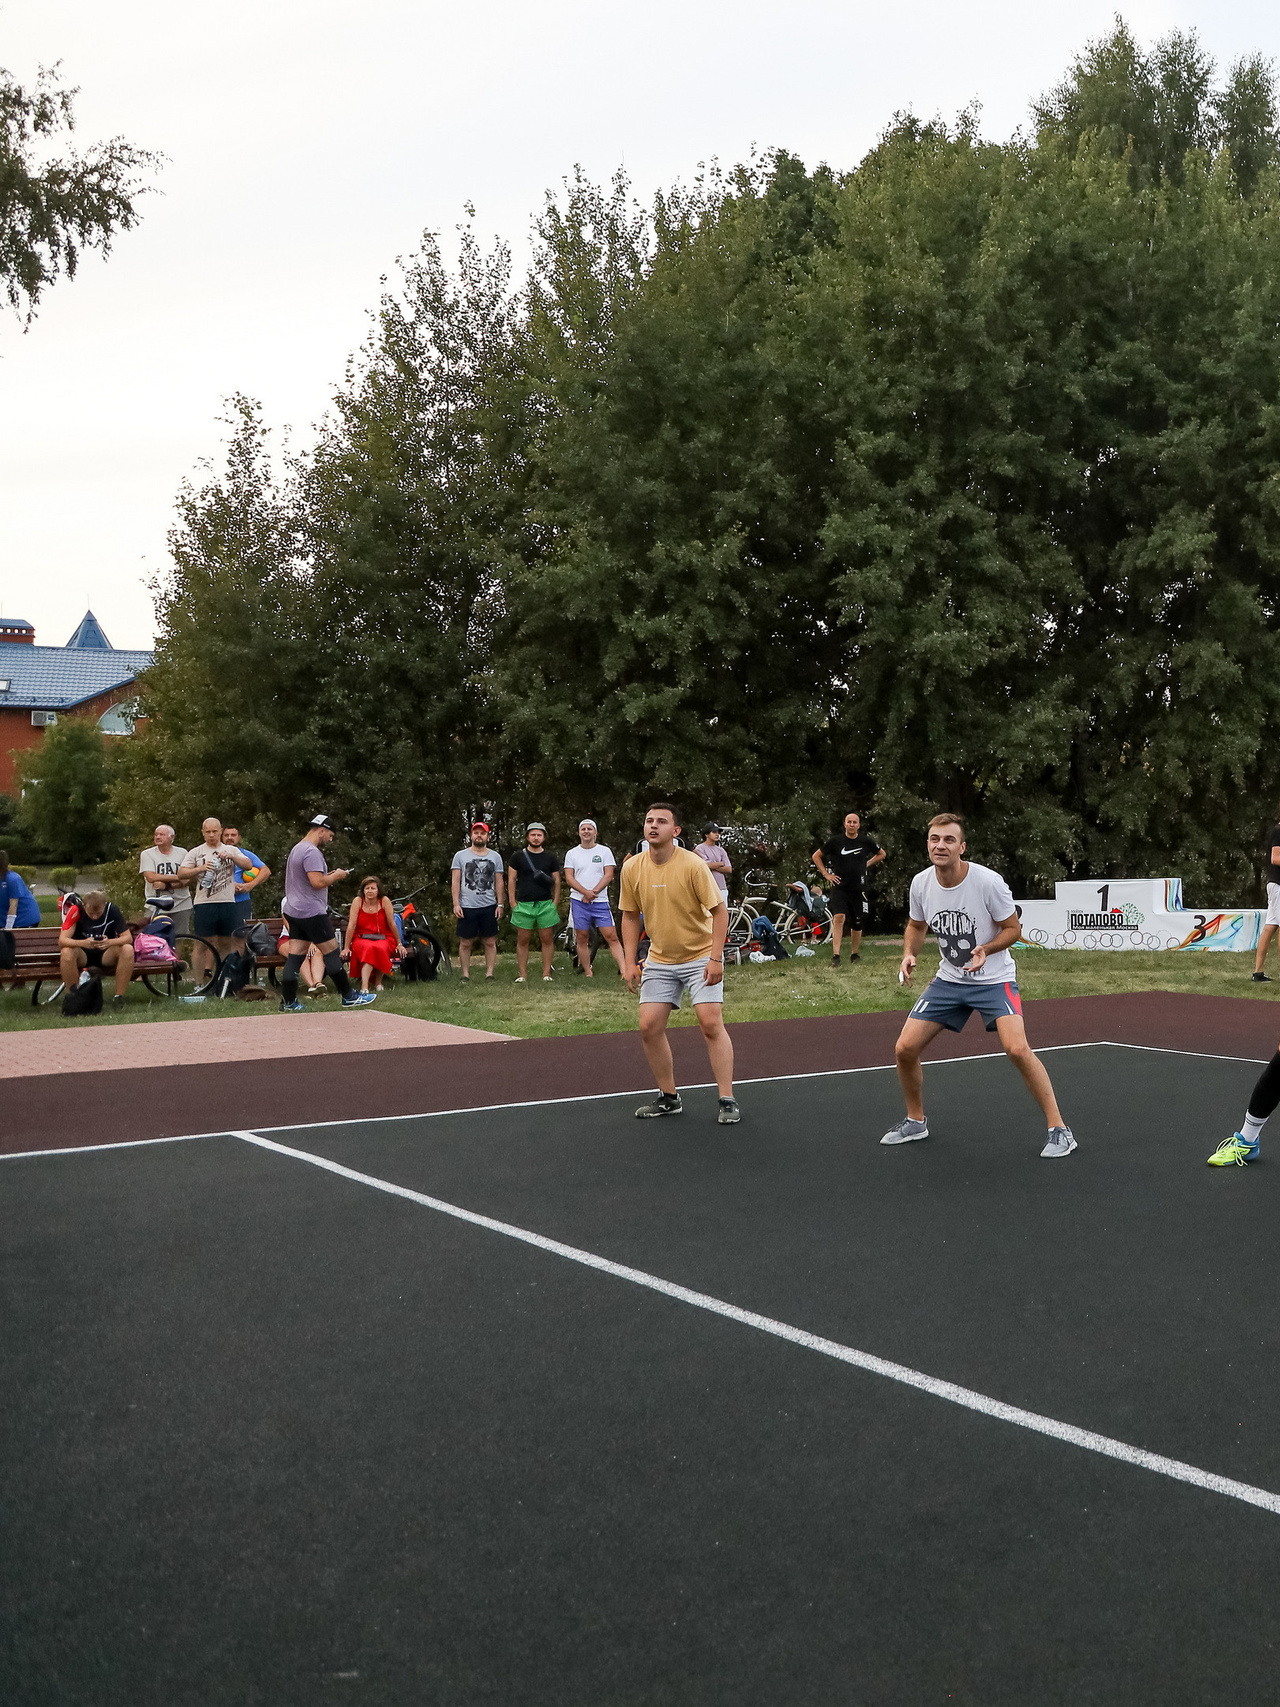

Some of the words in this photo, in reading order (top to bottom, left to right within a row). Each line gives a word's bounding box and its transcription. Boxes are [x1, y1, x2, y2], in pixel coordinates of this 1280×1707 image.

[1097, 884, 1109, 911] 1
[1070, 914, 1123, 926] ПОТАПОВО
[1191, 915, 1206, 943] 3
